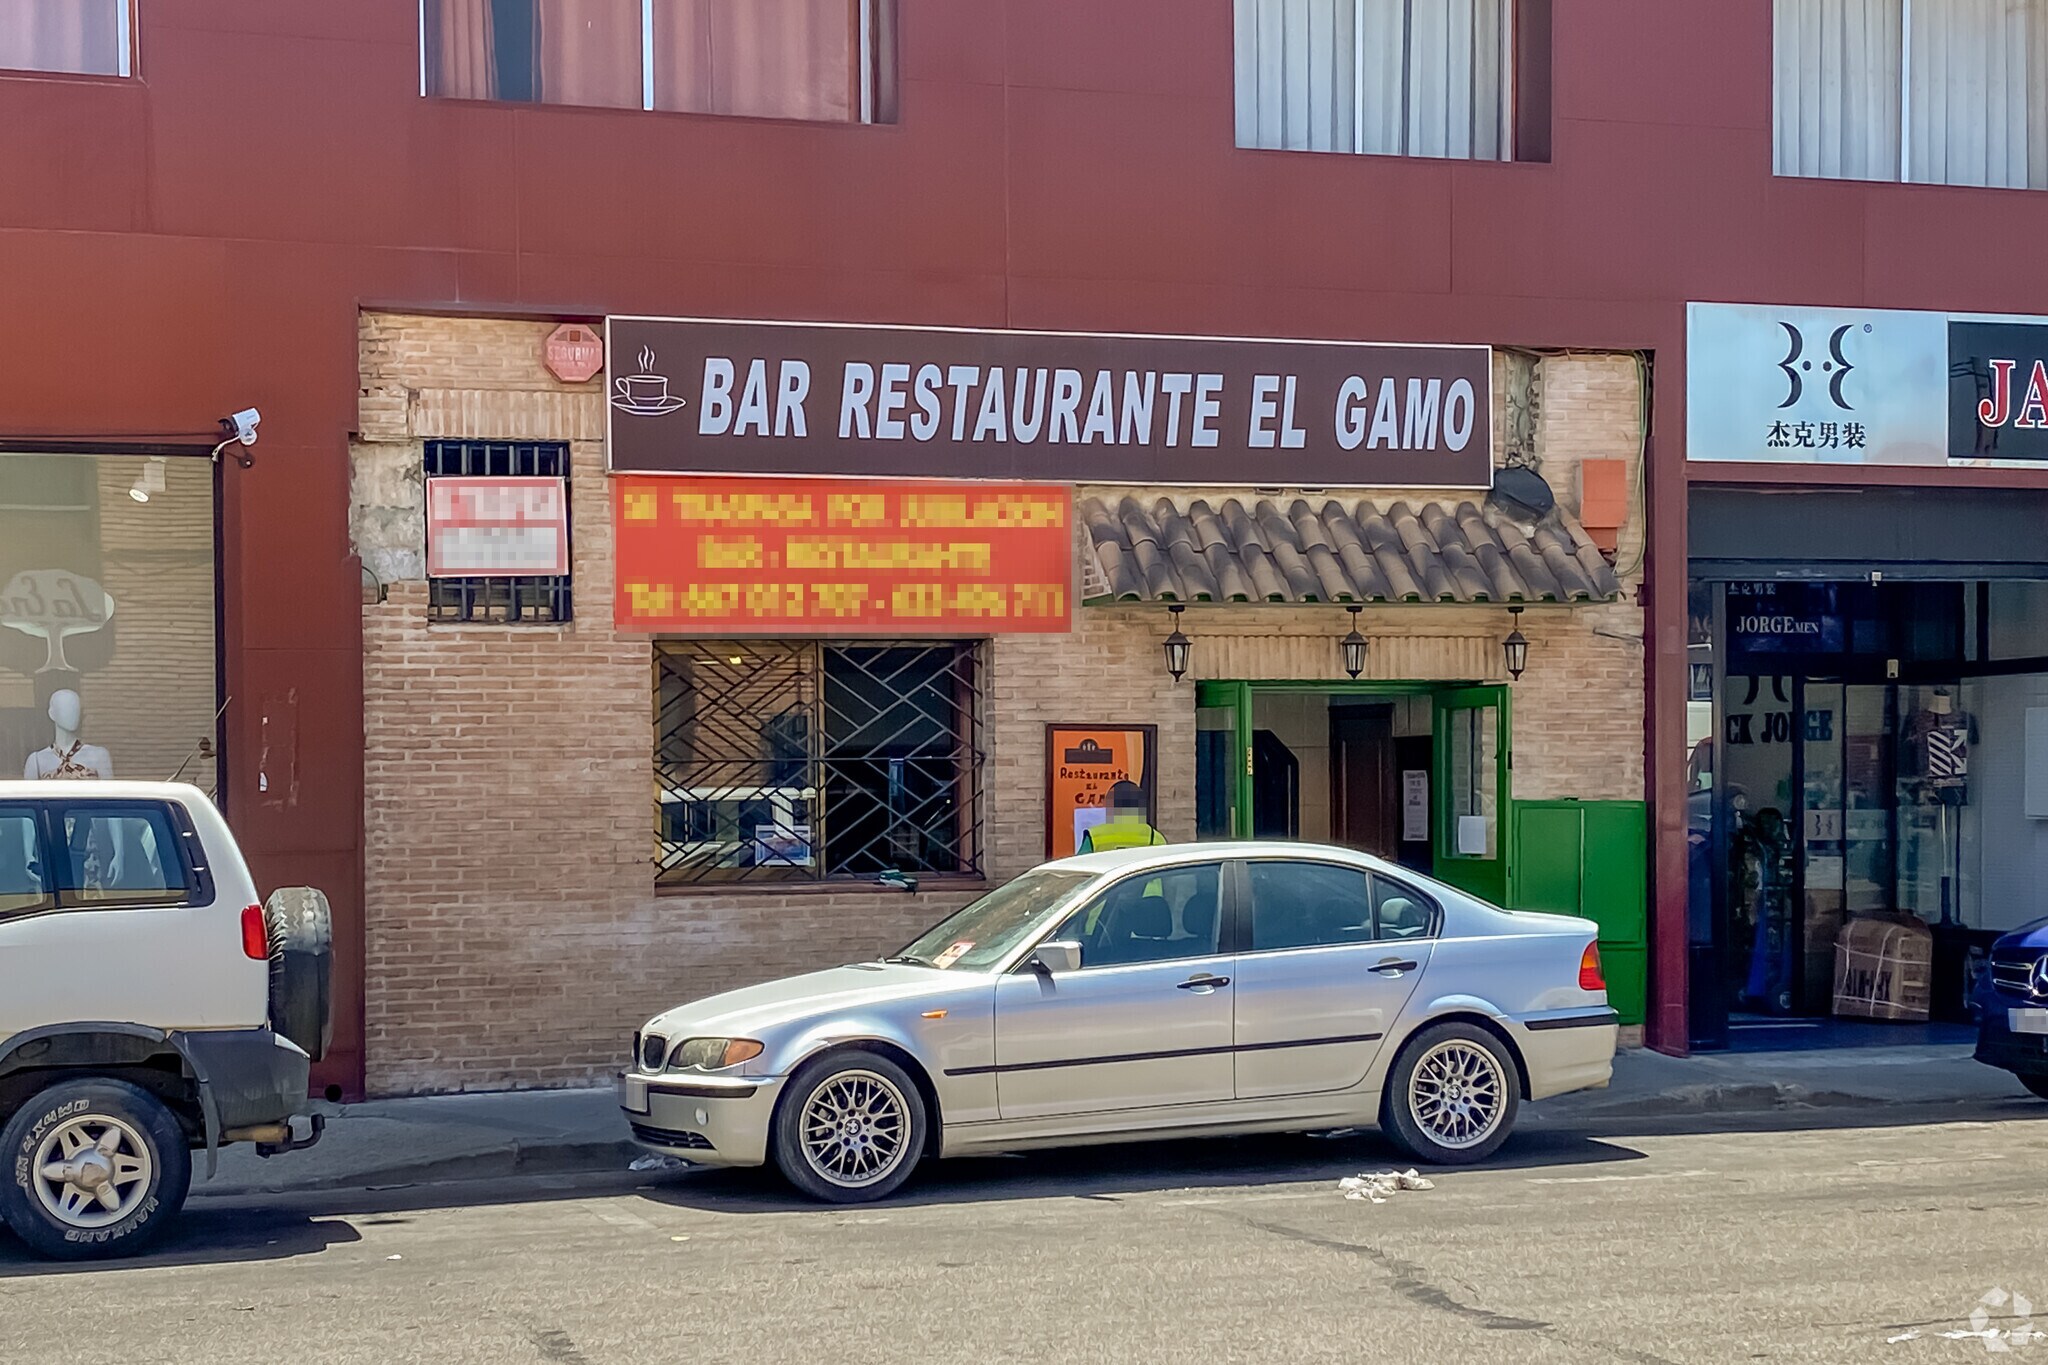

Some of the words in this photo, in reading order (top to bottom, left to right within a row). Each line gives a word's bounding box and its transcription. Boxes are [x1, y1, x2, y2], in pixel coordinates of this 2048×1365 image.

[699, 357, 811, 437] BAR
[838, 363, 1224, 448] RESTAURANTE
[1248, 375, 1306, 448] EL
[1335, 375, 1475, 452] GAMO
[1766, 420, 1867, 450] 杰克男装
[1761, 710, 1834, 743] JOGE
